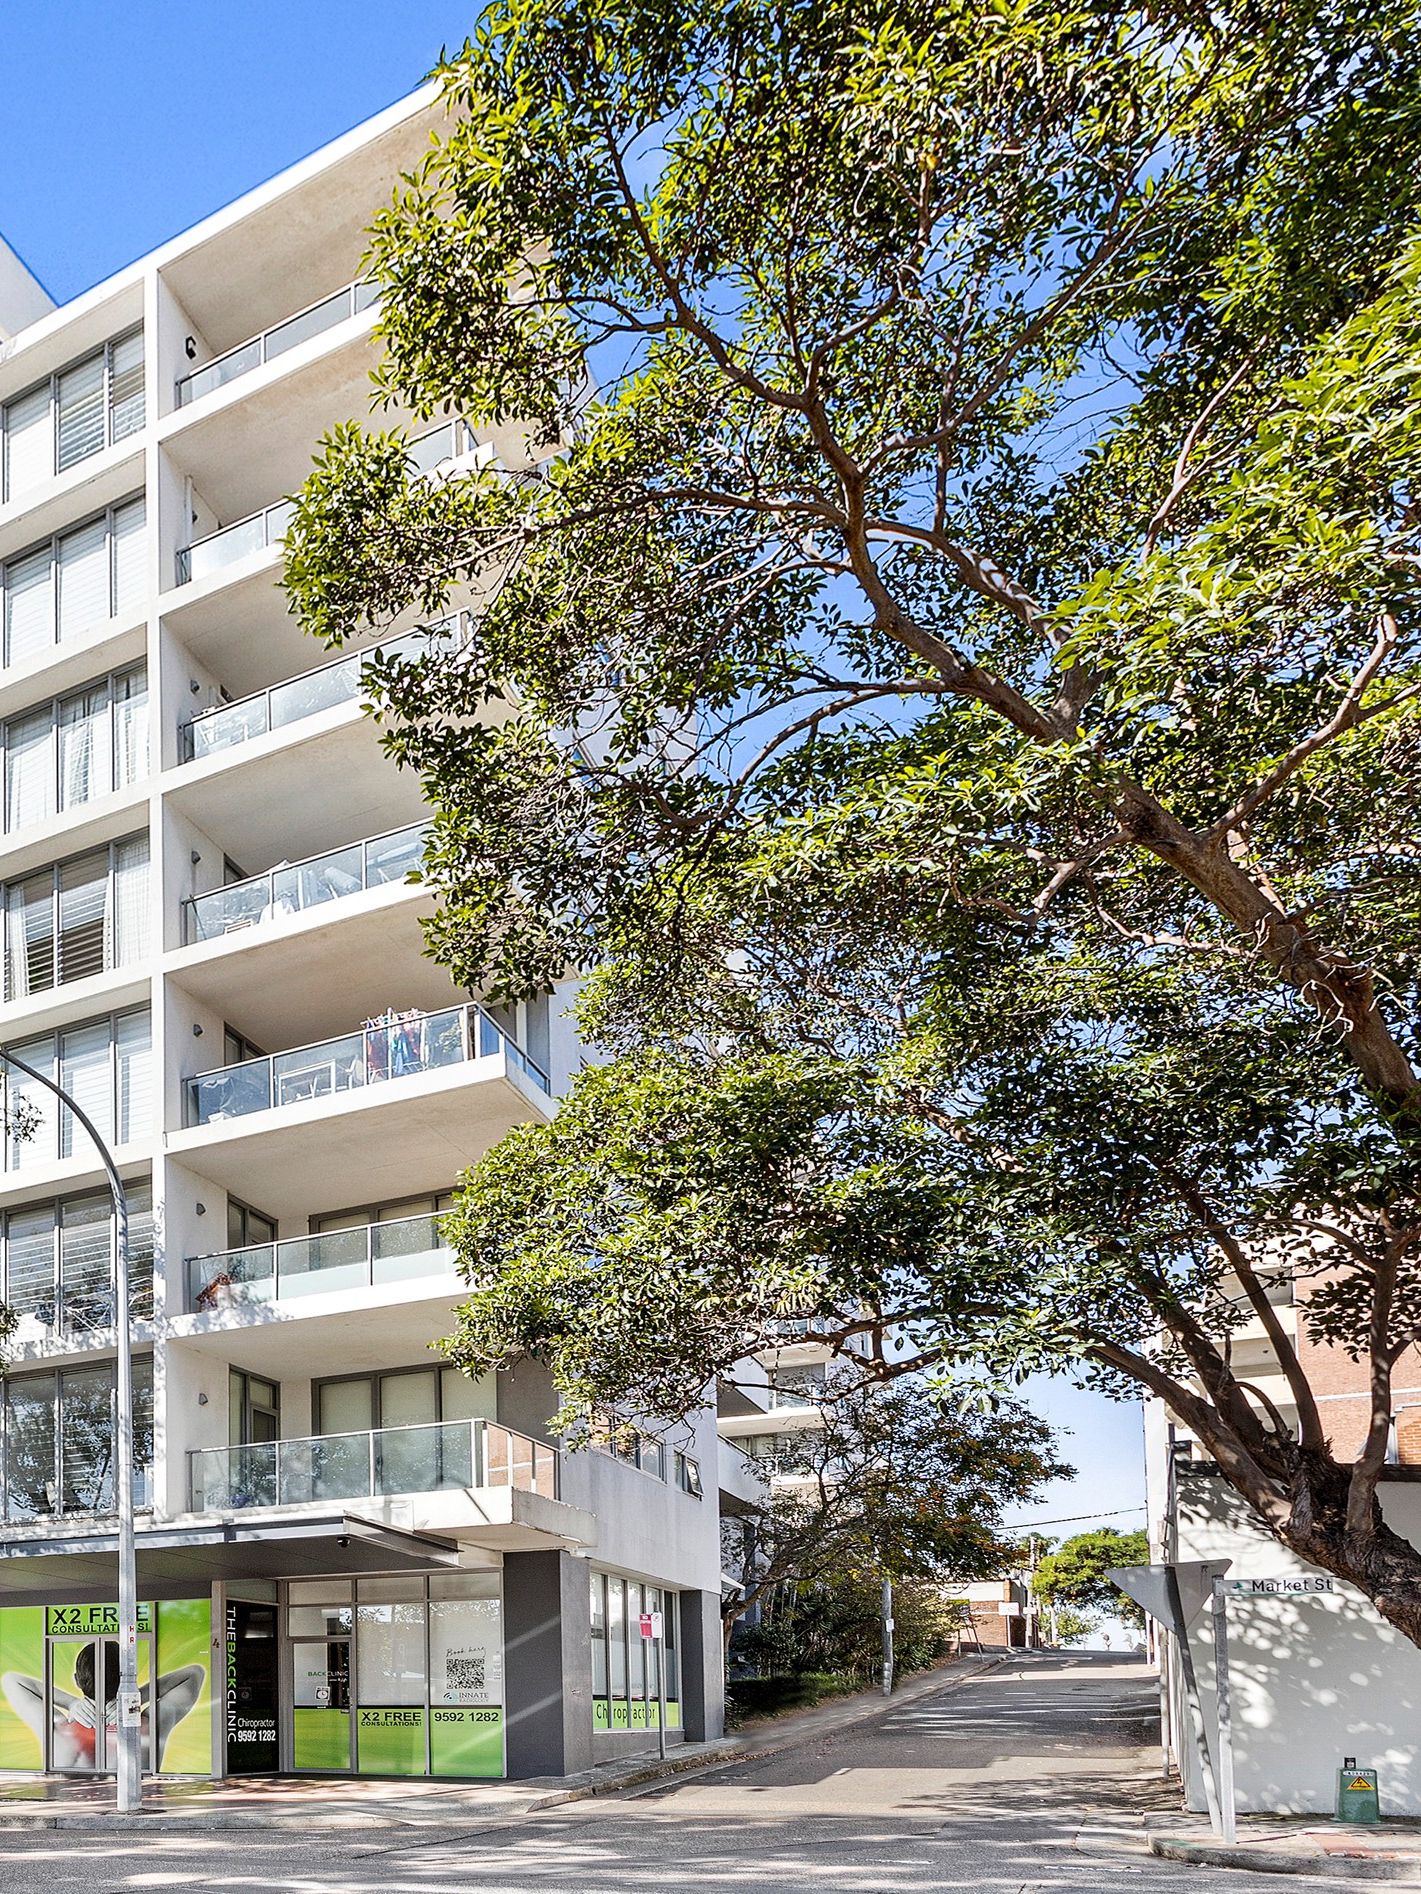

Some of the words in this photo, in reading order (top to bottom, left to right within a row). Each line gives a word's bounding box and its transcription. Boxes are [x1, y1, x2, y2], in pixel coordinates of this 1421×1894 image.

[1252, 1579, 1309, 1592] Market
[1315, 1578, 1332, 1591] St
[53, 1608, 81, 1625] X2
[89, 1605, 149, 1624] FRE
[51, 1623, 149, 1634] CONSULTATIS!
[362, 1712, 380, 1721] X2
[384, 1712, 422, 1721] FREE
[434, 1712, 464, 1722] 9592
[469, 1712, 499, 1722] 1282
[596, 1703, 655, 1723] Chropactor
[238, 1718, 275, 1729] Chiropractor
[238, 1730, 256, 1742] 9592
[258, 1730, 276, 1741] 1282
